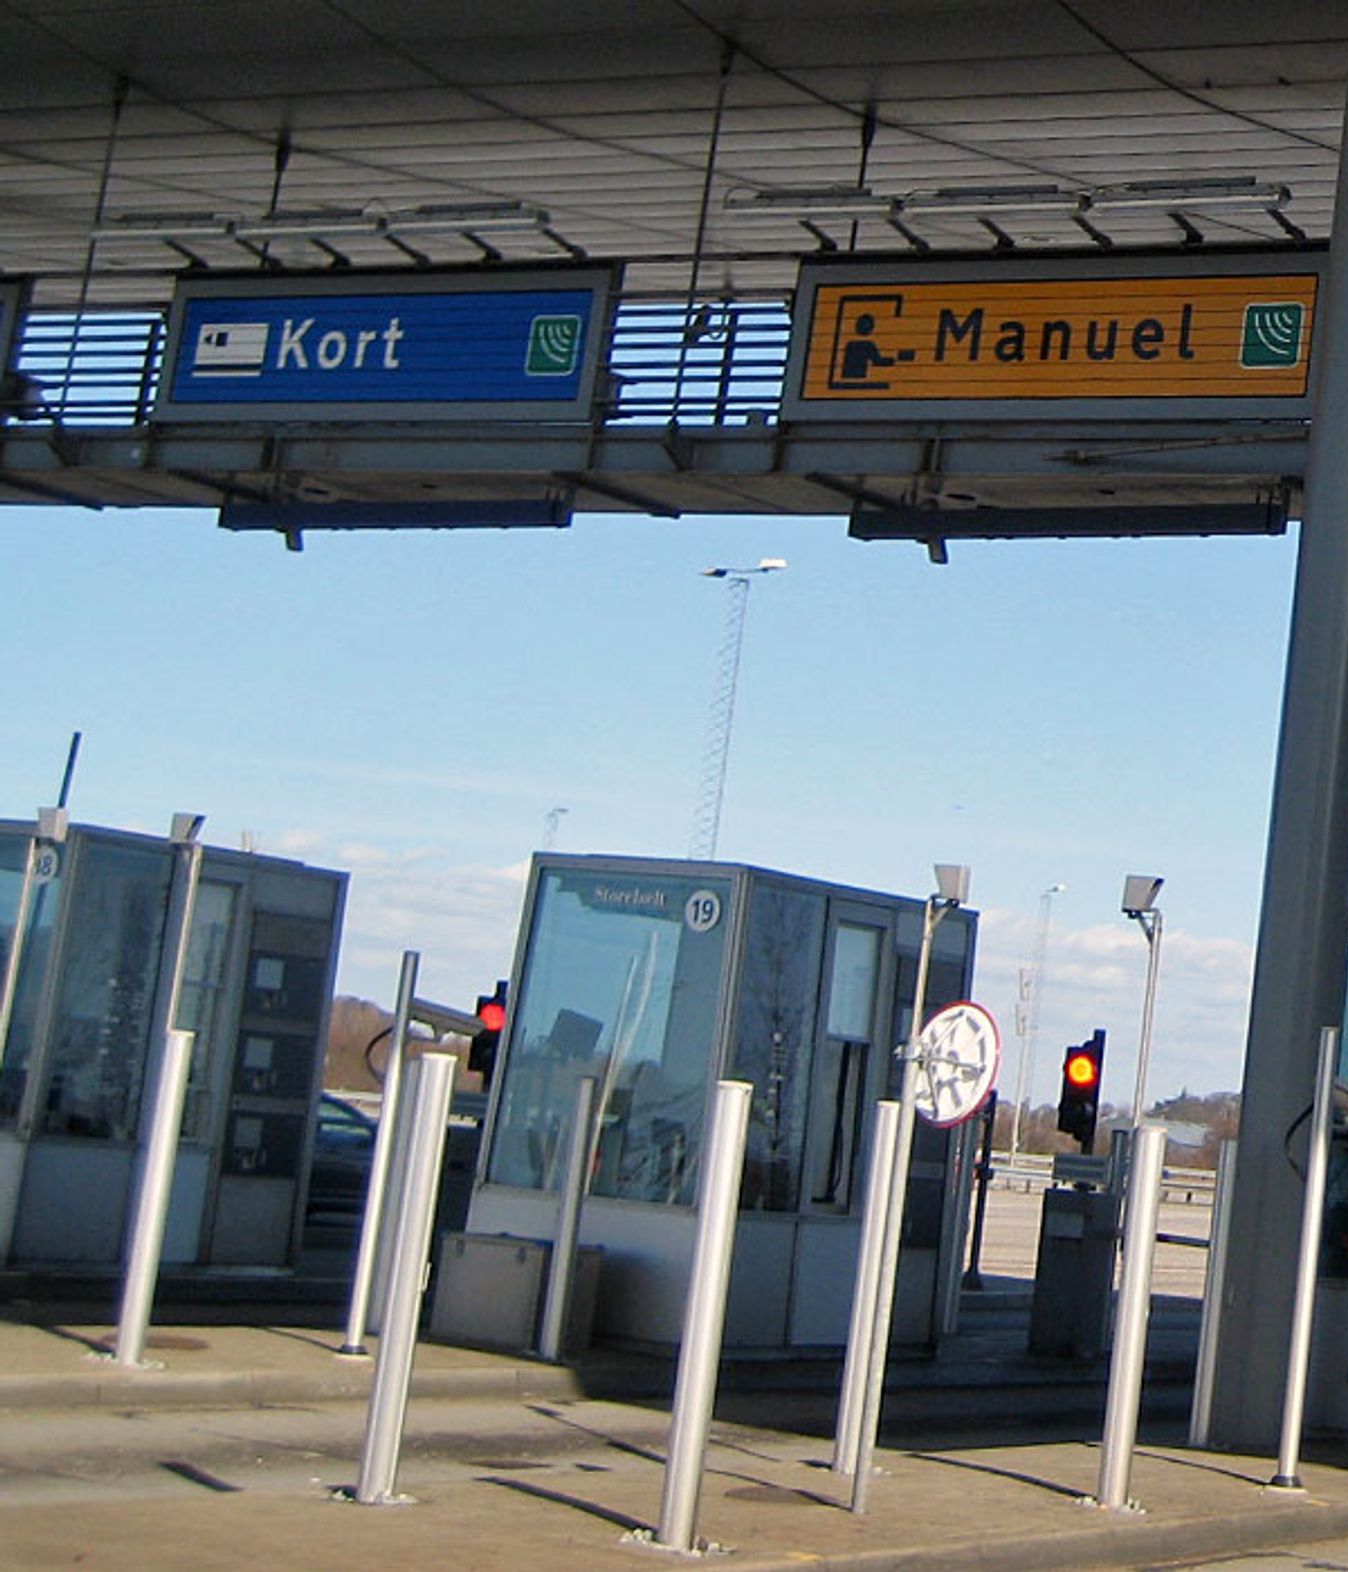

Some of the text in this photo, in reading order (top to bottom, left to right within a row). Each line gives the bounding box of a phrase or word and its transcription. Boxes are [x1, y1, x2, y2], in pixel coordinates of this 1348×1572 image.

[276, 317, 404, 369] Kort
[934, 303, 1196, 361] Manuel
[692, 899, 714, 924] 19
